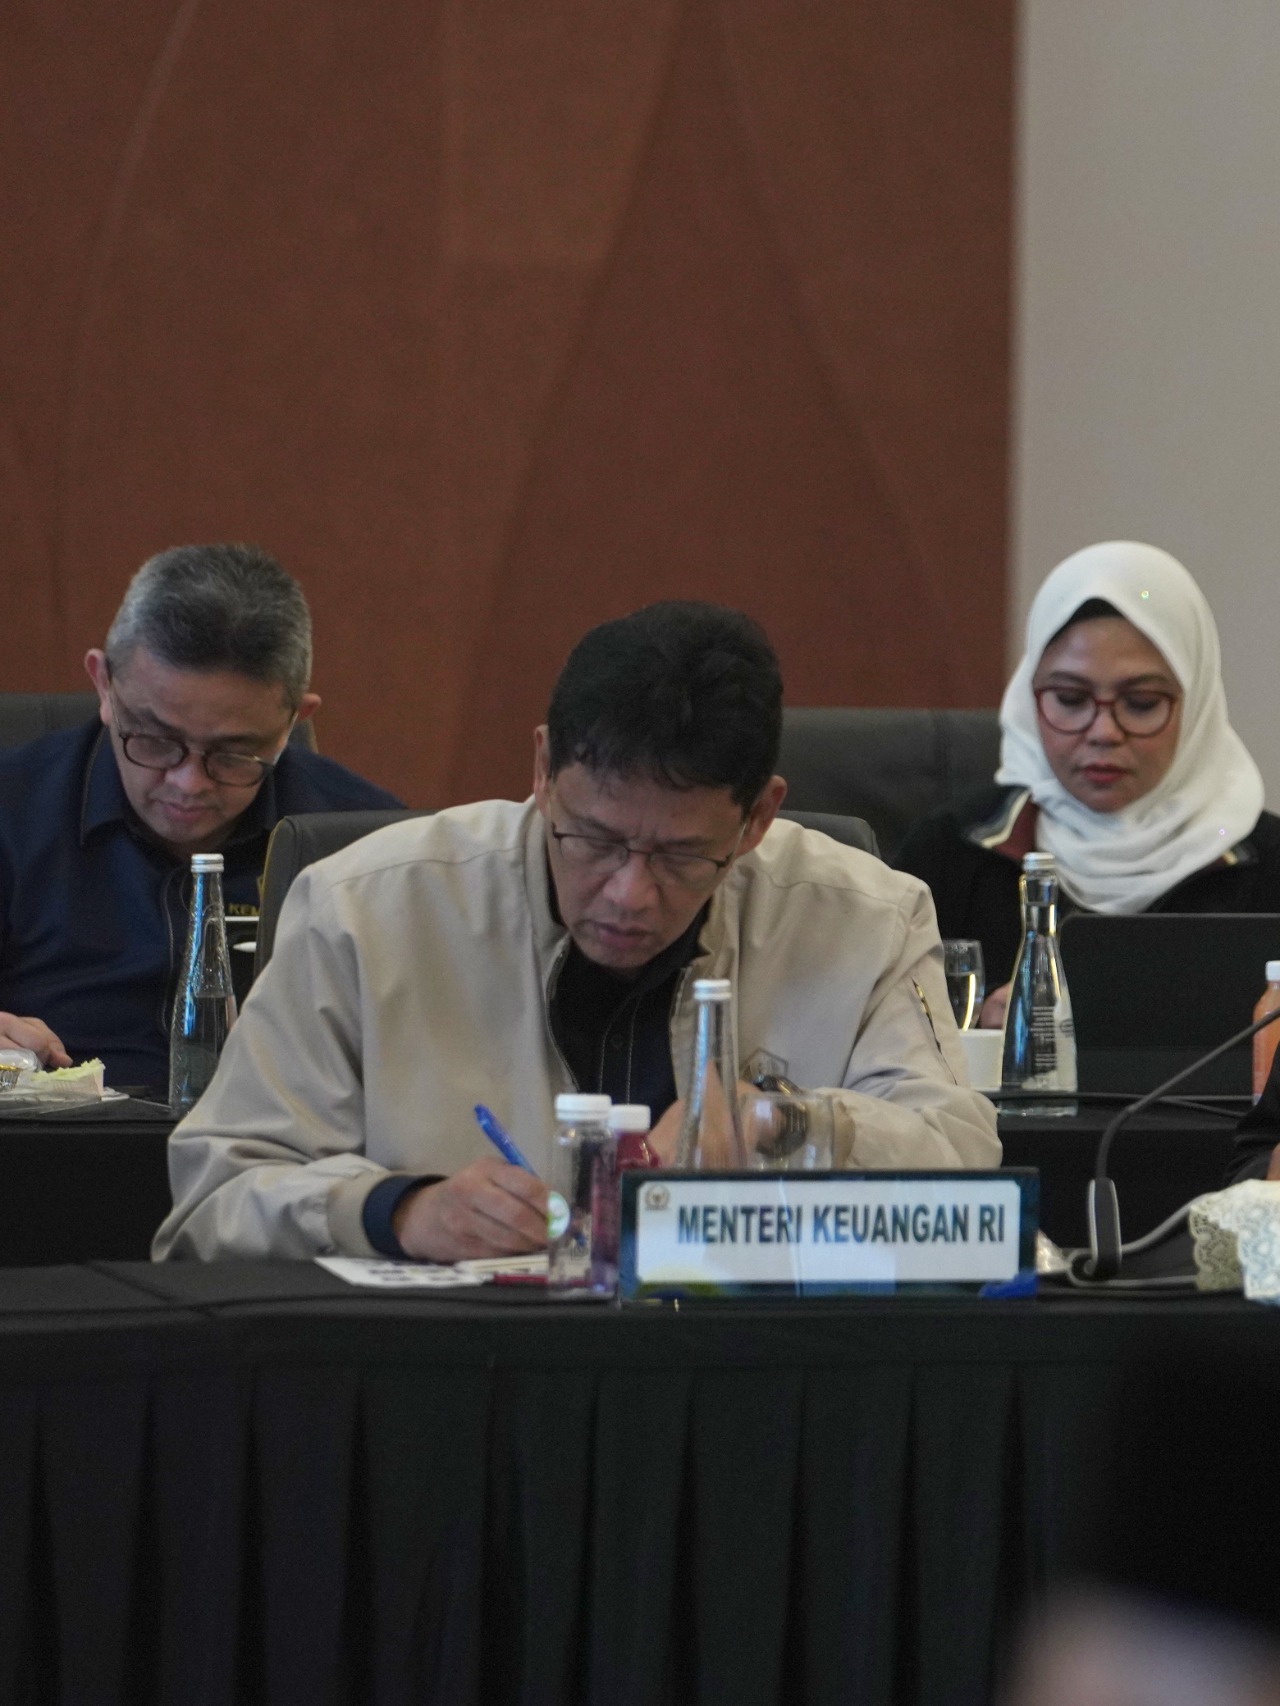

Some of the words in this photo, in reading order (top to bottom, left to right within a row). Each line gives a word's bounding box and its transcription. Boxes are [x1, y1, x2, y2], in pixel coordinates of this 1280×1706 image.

[677, 1204, 803, 1243] MENTERI
[812, 1204, 969, 1243] KEUANGAN
[978, 1204, 1005, 1242] RI
